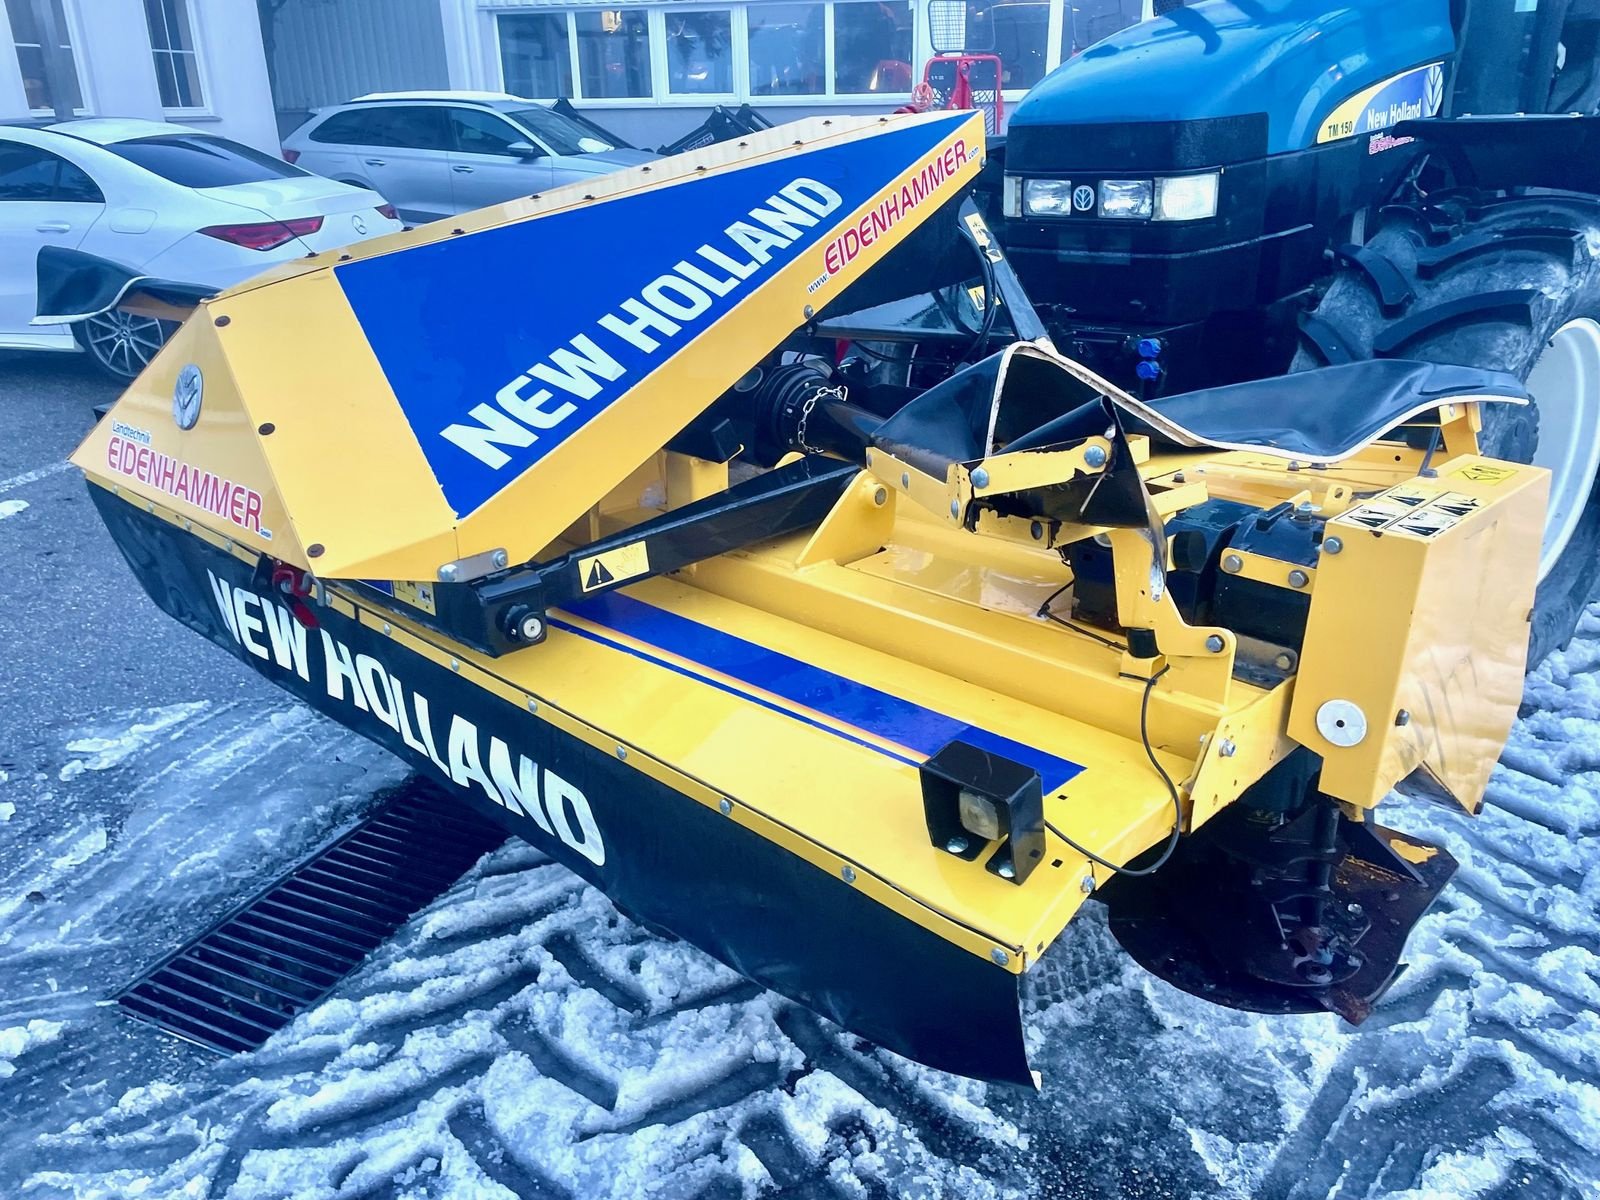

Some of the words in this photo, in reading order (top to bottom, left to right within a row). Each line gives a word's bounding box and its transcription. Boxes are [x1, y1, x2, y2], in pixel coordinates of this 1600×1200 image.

[1328, 123, 1338, 138] TM
[1341, 120, 1353, 134] 150
[1367, 108, 1388, 130] New
[1389, 98, 1422, 123] Holland
[439, 333, 627, 471] NEW
[596, 177, 843, 355] HOLLAND
[112, 420, 151, 444] Landtechnik
[108, 436, 262, 533] EIDENHAMMER
[206, 568, 310, 682] NEW
[320, 628, 606, 867] HOLLAND
